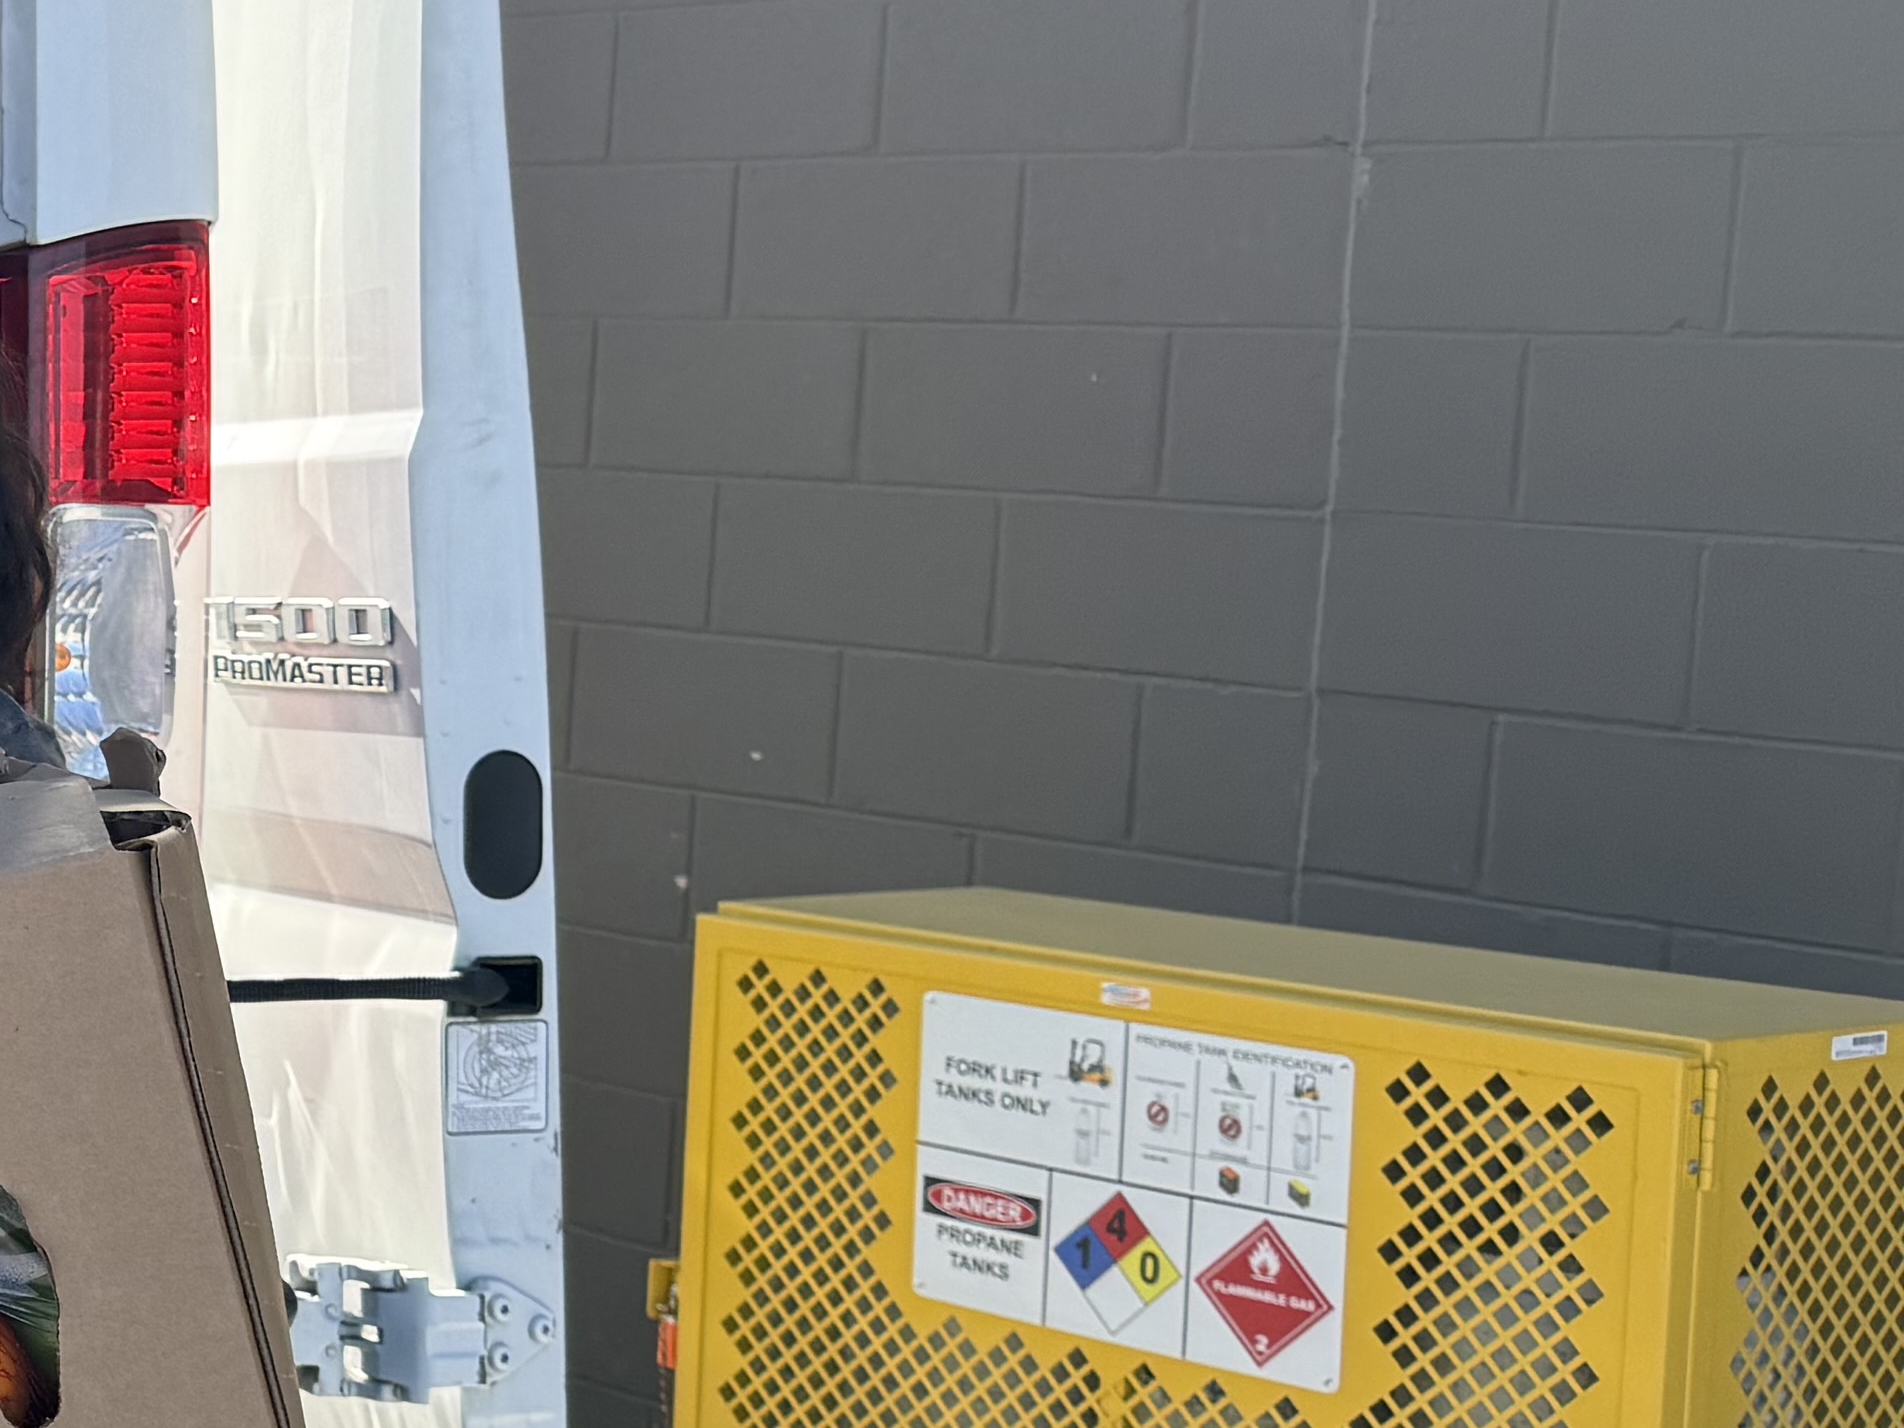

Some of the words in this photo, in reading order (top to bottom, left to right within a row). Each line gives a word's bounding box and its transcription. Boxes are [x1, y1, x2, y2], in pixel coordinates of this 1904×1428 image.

[204, 596, 392, 646] 1500
[944, 1056, 997, 1082] FORK
[1000, 1065, 1042, 1090] LIFT
[934, 1078, 997, 1109] TANKS
[1000, 1091, 1051, 1118] ONLY
[939, 1183, 1024, 1225] DANGER
[936, 1221, 1025, 1260] PROPANE
[1106, 1209, 1129, 1243] 4
[948, 1250, 1011, 1282] TANKS
[1074, 1236, 1092, 1270] 1
[1140, 1251, 1160, 1285] 0
[1211, 1278, 1282, 1307] FLAMMABLE
[1283, 1291, 1317, 1314] GAS
[1252, 1333, 1270, 1354] 2
